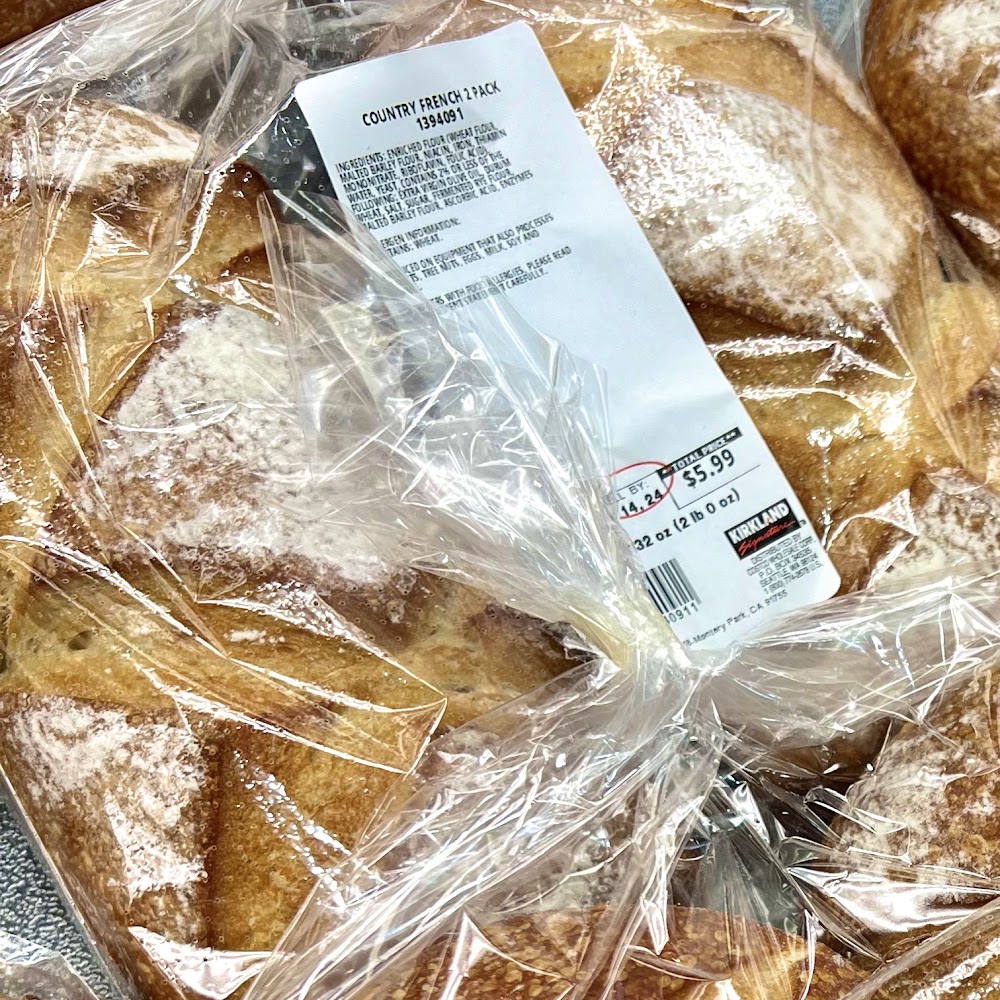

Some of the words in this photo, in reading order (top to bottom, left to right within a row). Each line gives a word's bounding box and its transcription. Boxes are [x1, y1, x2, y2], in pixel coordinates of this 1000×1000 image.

[361, 100, 417, 126] COUNTRY
[418, 90, 463, 112] FRENCH
[463, 87, 472, 100] 2
[471, 80, 501, 99] PACK
[416, 107, 464, 131] 1394091
[476, 235, 496, 248] THAT
[496, 228, 515, 241] ALSO
[526, 254, 553, 270] PLEASE
[552, 246, 571, 259] READ
[681, 448, 736, 489] $5.99
[643, 488, 664, 506] 24
[633, 535, 654, 551] 32
[654, 527, 672, 542] oz
[672, 516, 690, 533] (2
[689, 509, 704, 523] lb
[705, 502, 716, 515] 0
[718, 487, 741, 508] oz)
[727, 502, 790, 544] KIRKLAND
[749, 602, 764, 614] CA
